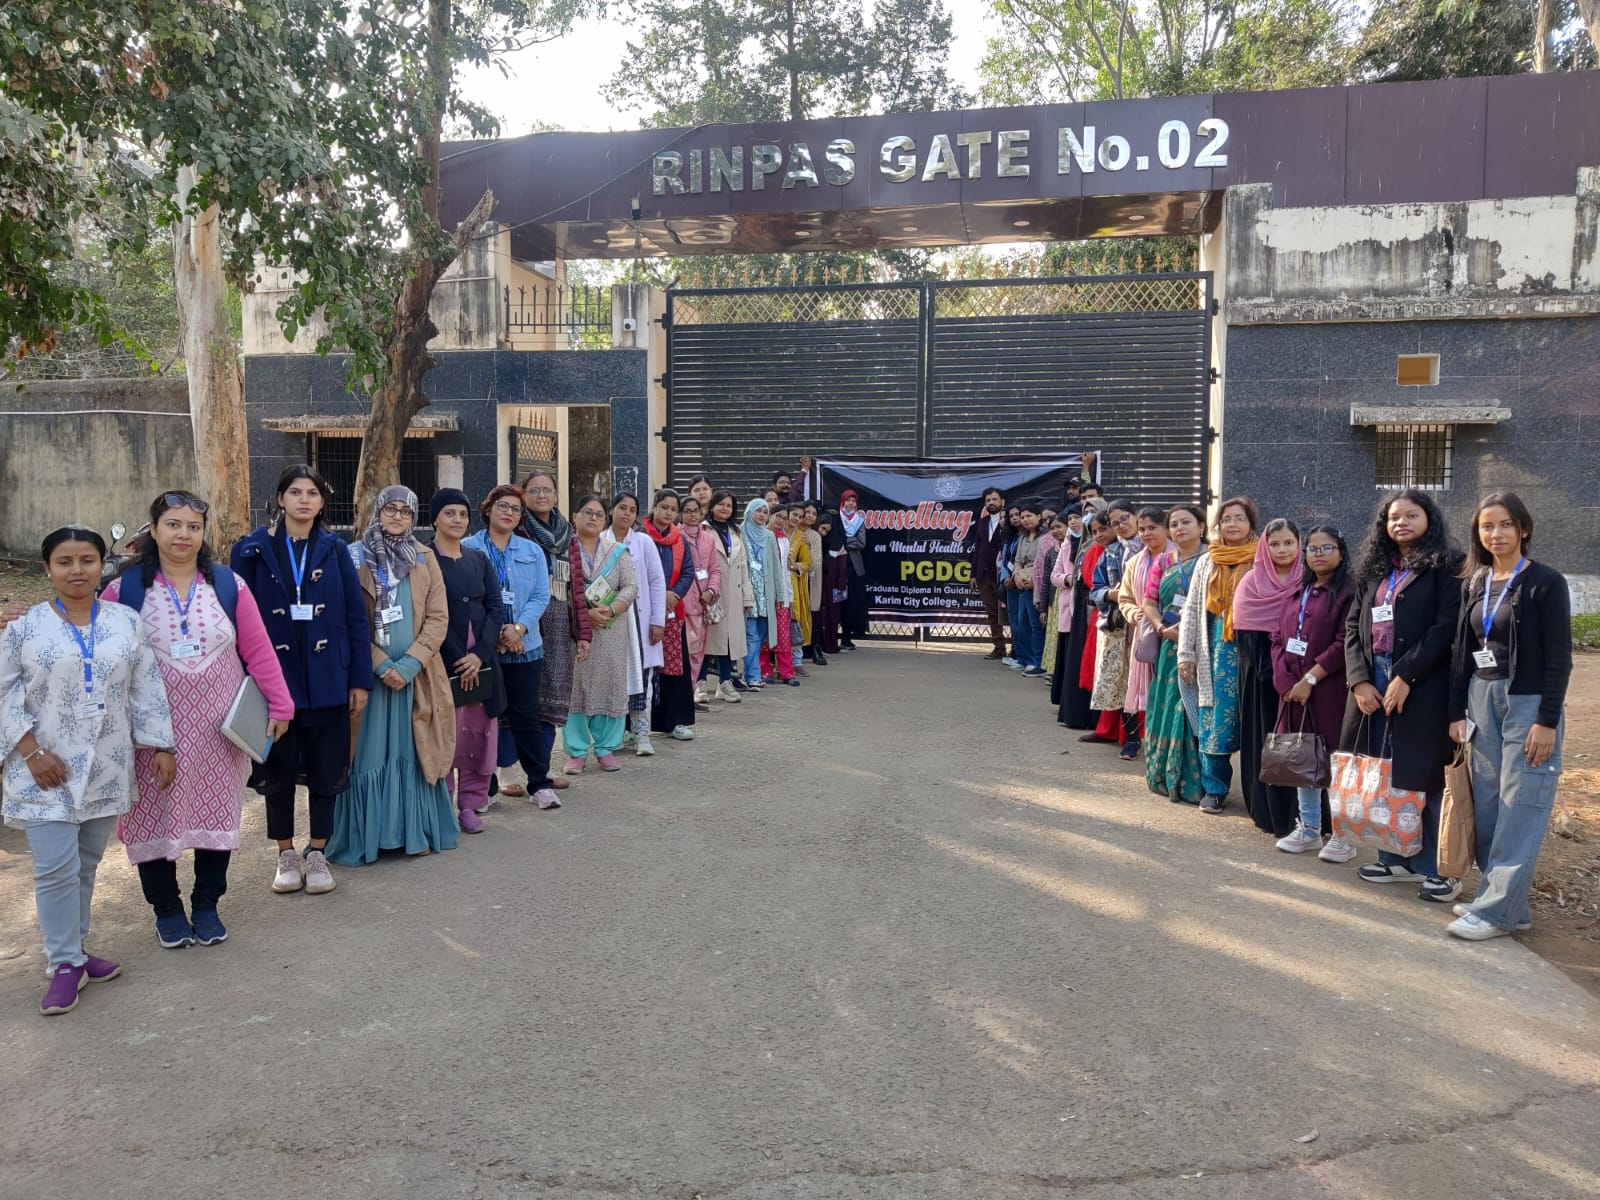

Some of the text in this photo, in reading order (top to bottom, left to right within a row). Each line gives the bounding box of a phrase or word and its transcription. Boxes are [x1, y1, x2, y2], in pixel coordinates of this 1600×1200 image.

[652, 118, 1230, 195] RINPAS GATE No.02
[874, 544, 886, 552] on
[889, 541, 927, 553] Mental
[929, 541, 963, 554] Health
[901, 585, 932, 596] Diploma
[933, 586, 942, 594] in
[875, 595, 902, 605] Karim
[903, 596, 921, 608] City
[922, 596, 960, 608] College,
